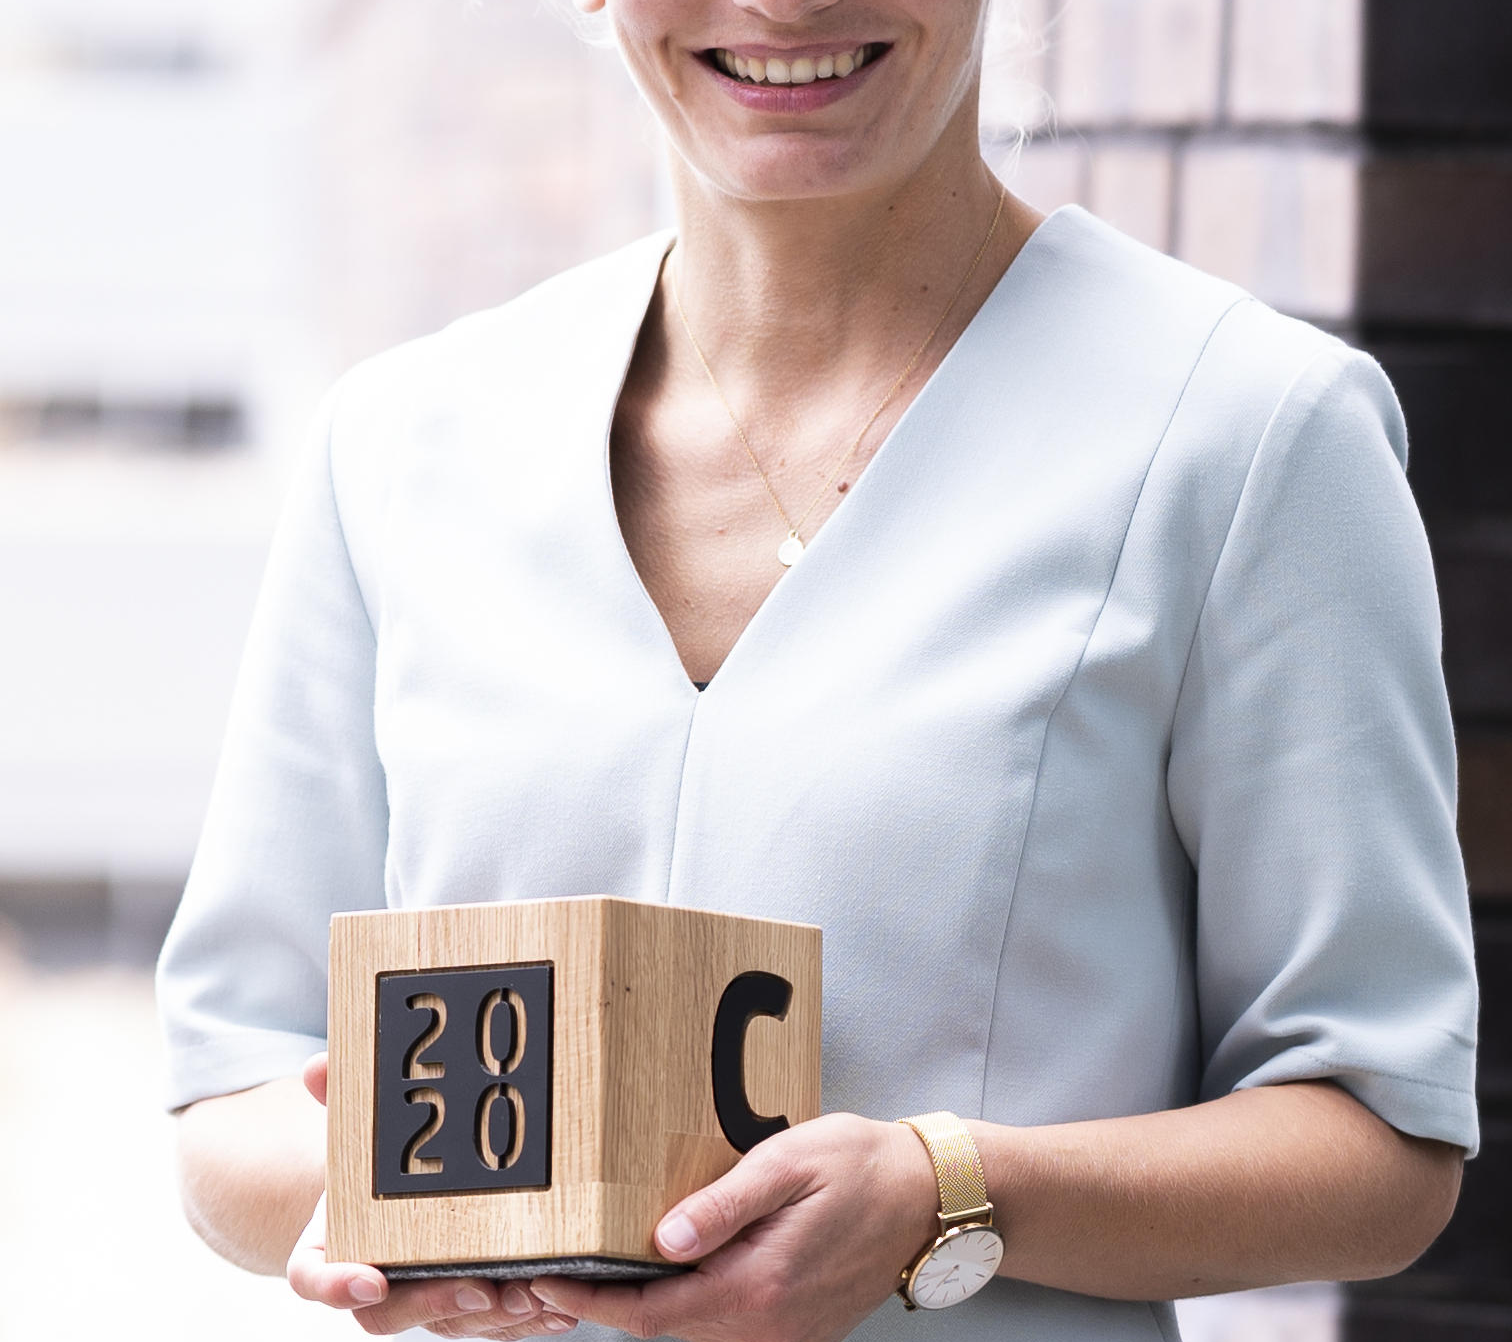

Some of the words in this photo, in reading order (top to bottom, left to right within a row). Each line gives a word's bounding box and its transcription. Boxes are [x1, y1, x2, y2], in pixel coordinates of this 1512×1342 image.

[401, 987, 527, 1081] 20
[711, 970, 794, 1157] C
[399, 1081, 526, 1175] 20
